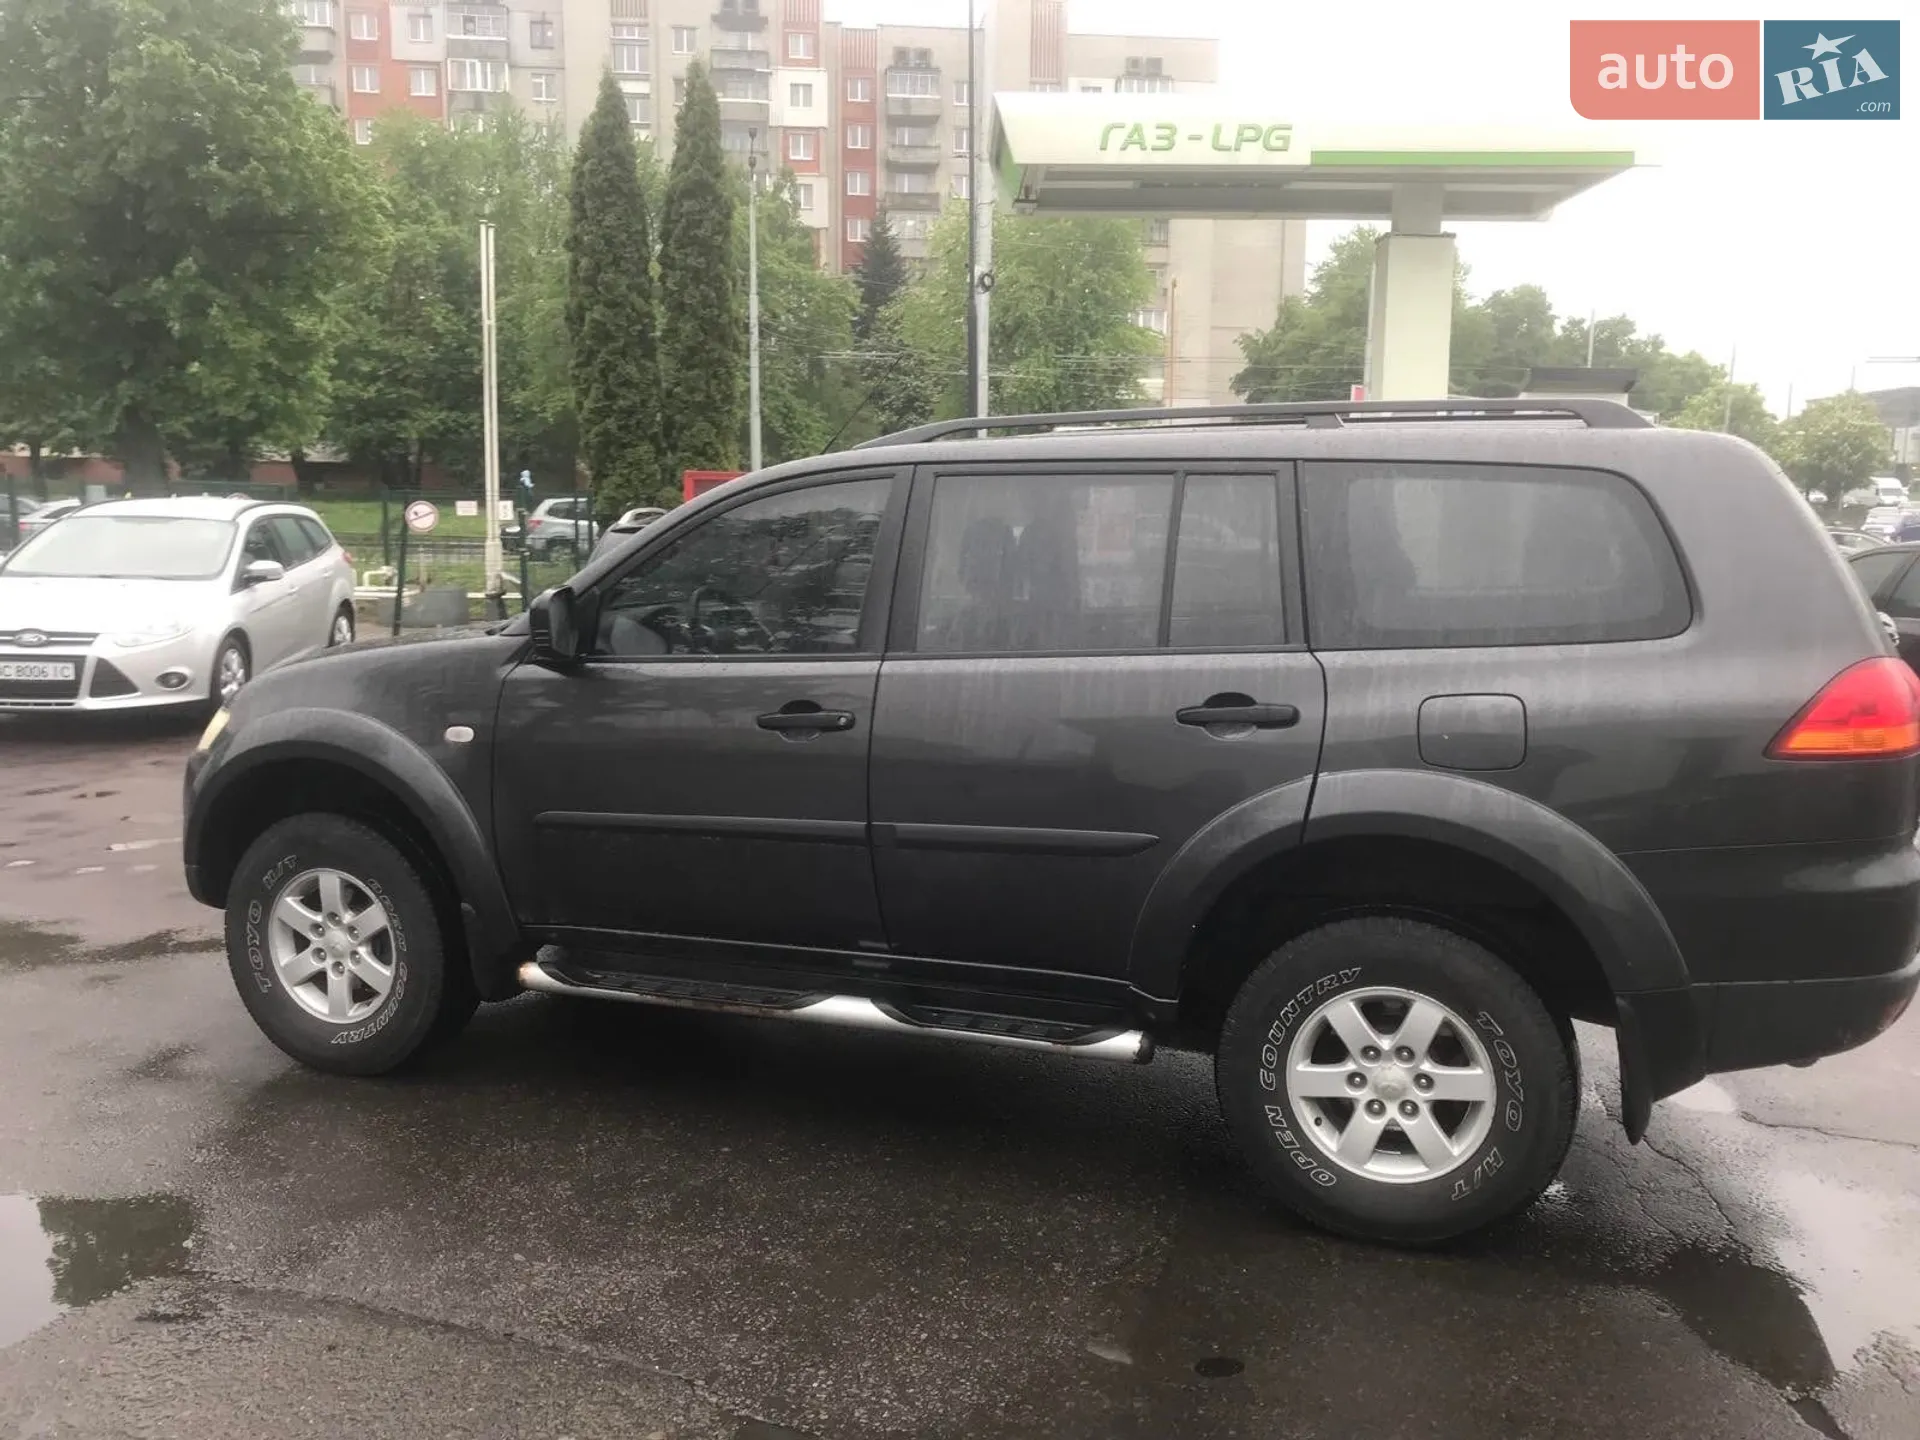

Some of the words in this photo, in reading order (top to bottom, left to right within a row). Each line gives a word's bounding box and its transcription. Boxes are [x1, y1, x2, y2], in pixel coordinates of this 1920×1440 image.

[1099, 122, 1178, 151] ГАЗ
[1211, 122, 1293, 152] LPG
[247, 899, 272, 993] TOYO
[331, 961, 408, 1044] COUNTRY
[1259, 967, 1362, 1091] COUNTRY
[1476, 1010, 1524, 1132] TOYO
[1264, 1105, 1337, 1187] OPEN
[1451, 1146, 1505, 1201] H/T
